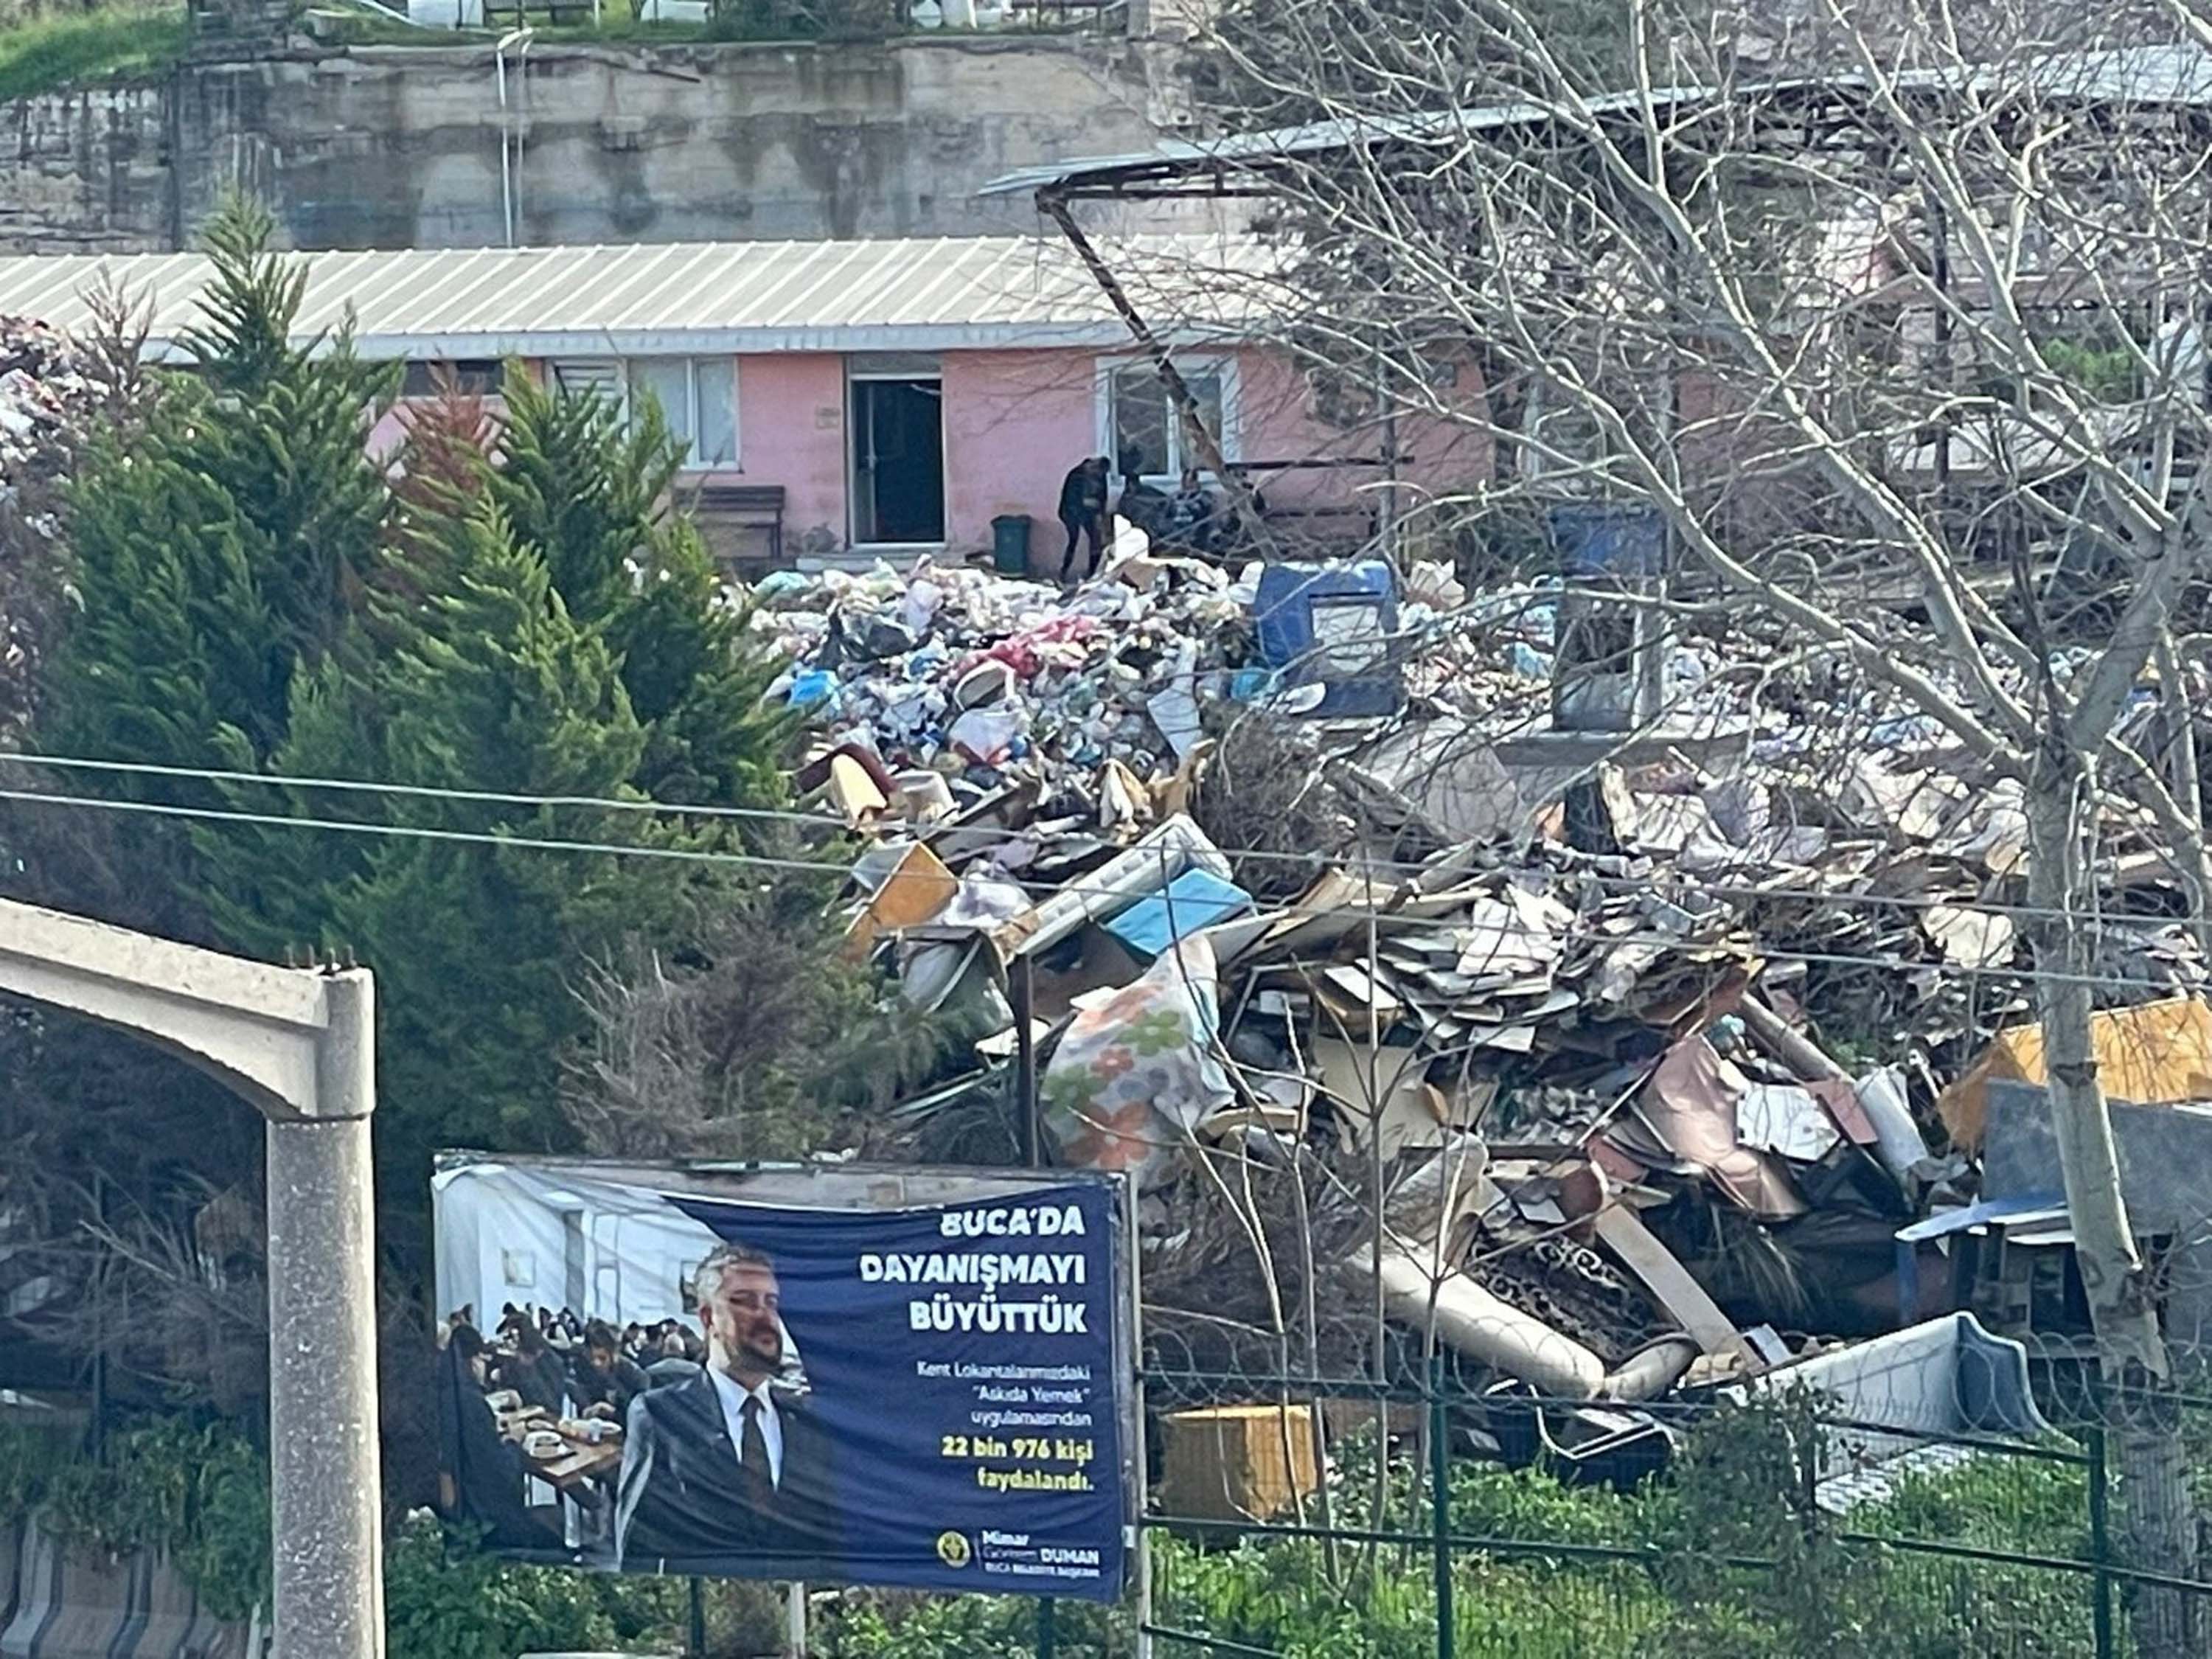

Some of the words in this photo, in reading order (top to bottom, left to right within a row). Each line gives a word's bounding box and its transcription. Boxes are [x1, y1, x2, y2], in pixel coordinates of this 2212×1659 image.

[941, 1206, 1085, 1237] BUCA'DA
[860, 1253, 1085, 1293] DAYANIŞMAYI
[910, 1293, 1088, 1333] BÜYÜTTÜK
[917, 1360, 950, 1377] Kent
[942, 1436, 968, 1456] 22
[973, 1436, 1007, 1457] bin
[1012, 1439, 1051, 1458] 976
[1056, 1439, 1093, 1467] kişi
[978, 1467, 1095, 1492] faydalandı.
[981, 1530, 1030, 1545] Mimar
[1040, 1548, 1099, 1565] DUMAN
